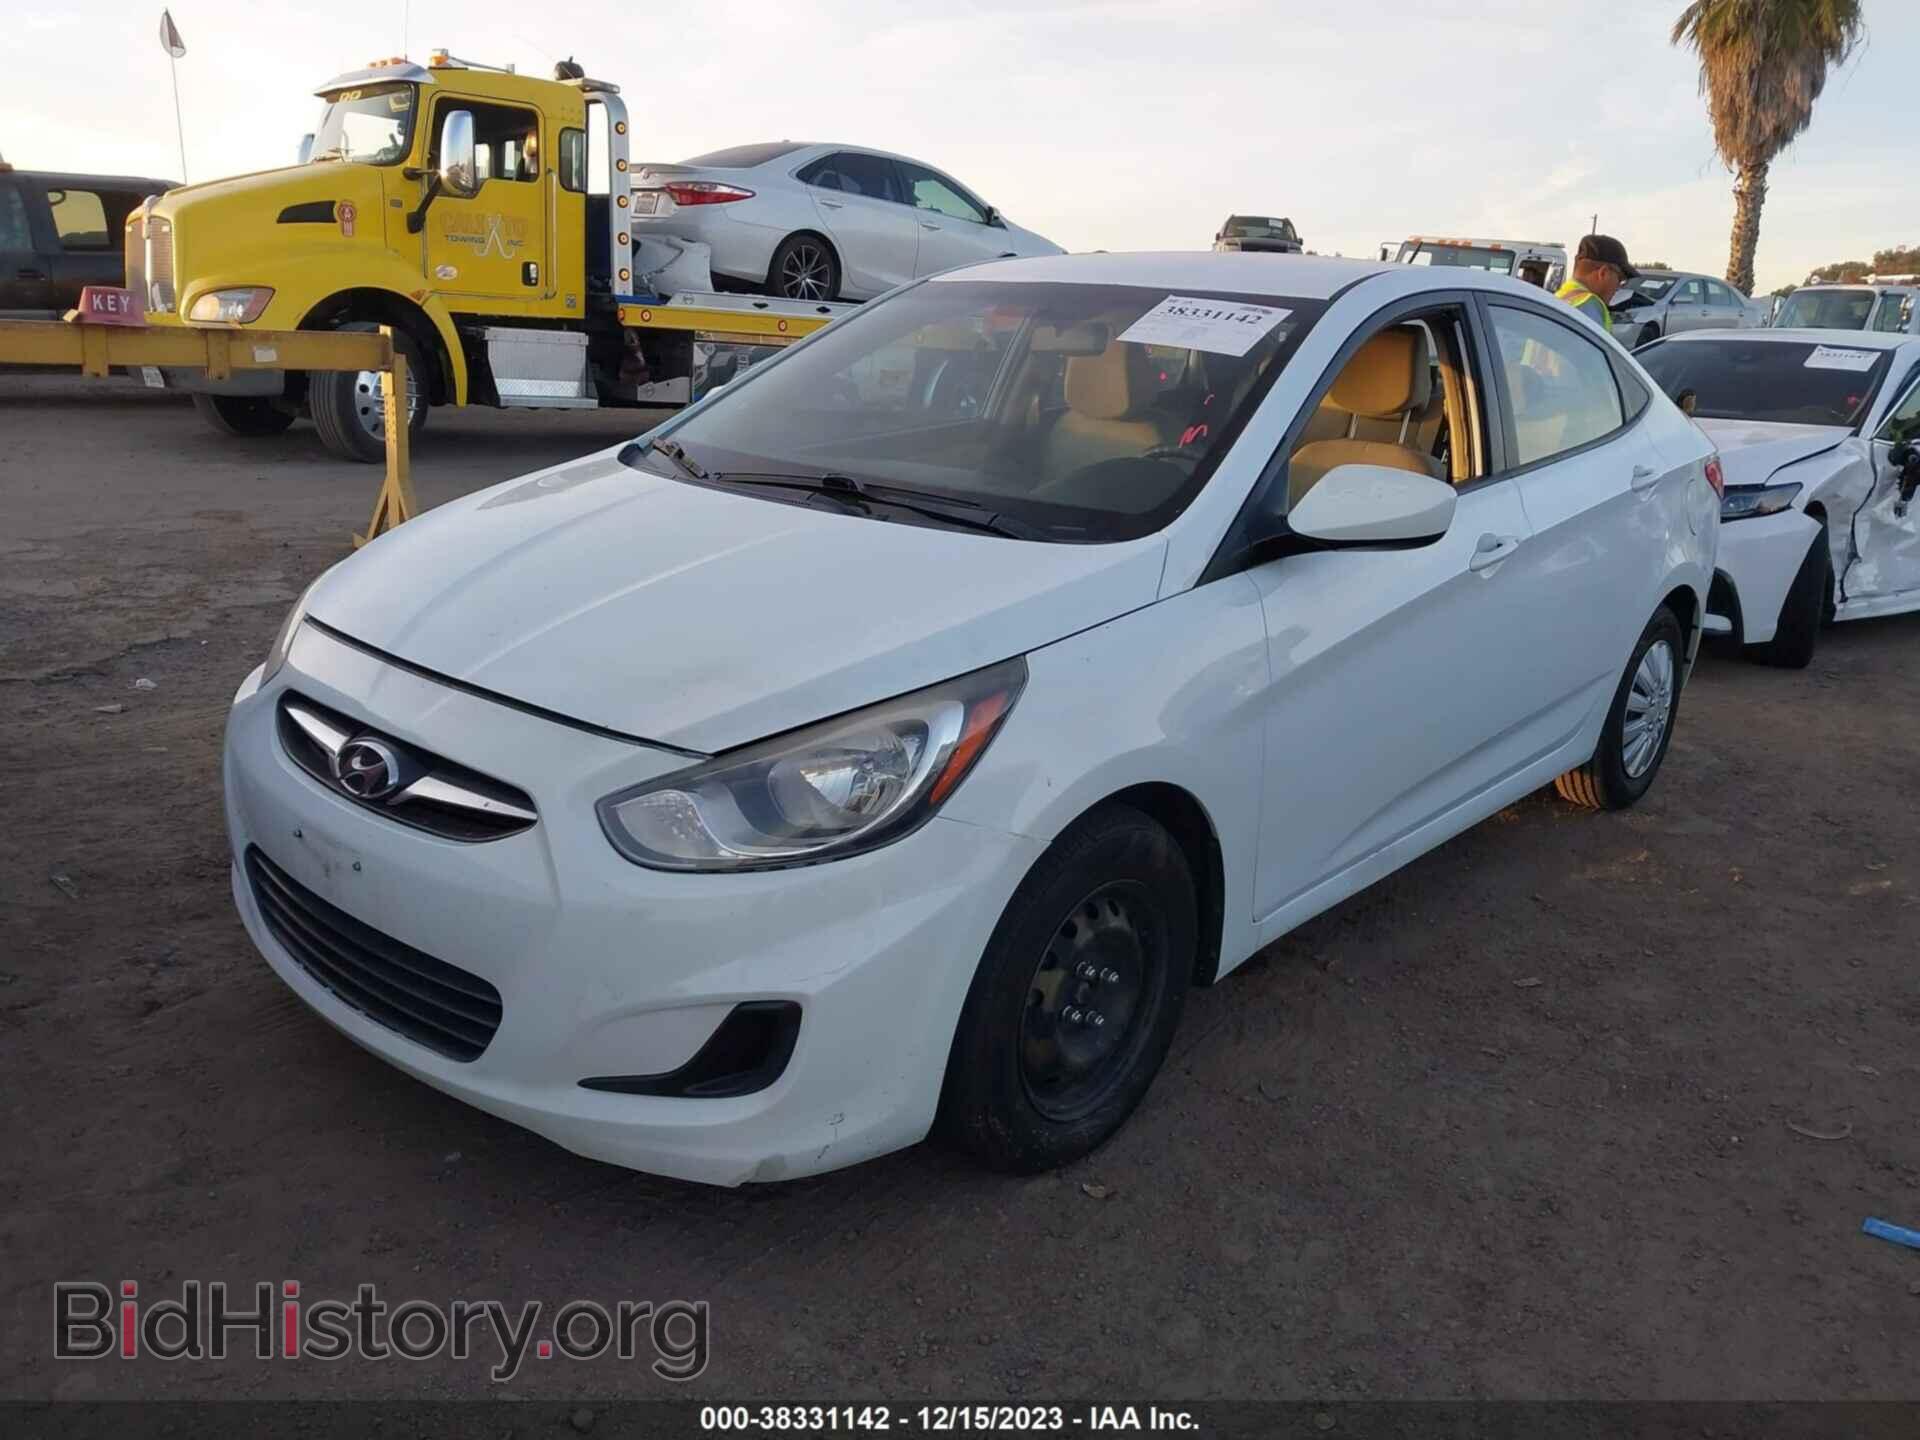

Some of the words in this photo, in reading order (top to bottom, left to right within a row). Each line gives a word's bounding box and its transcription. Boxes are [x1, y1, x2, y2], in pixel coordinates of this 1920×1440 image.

[445, 234, 486, 245] TOWING
[92, 294, 130, 312] KEY
[1167, 306, 1263, 325] 38331142
